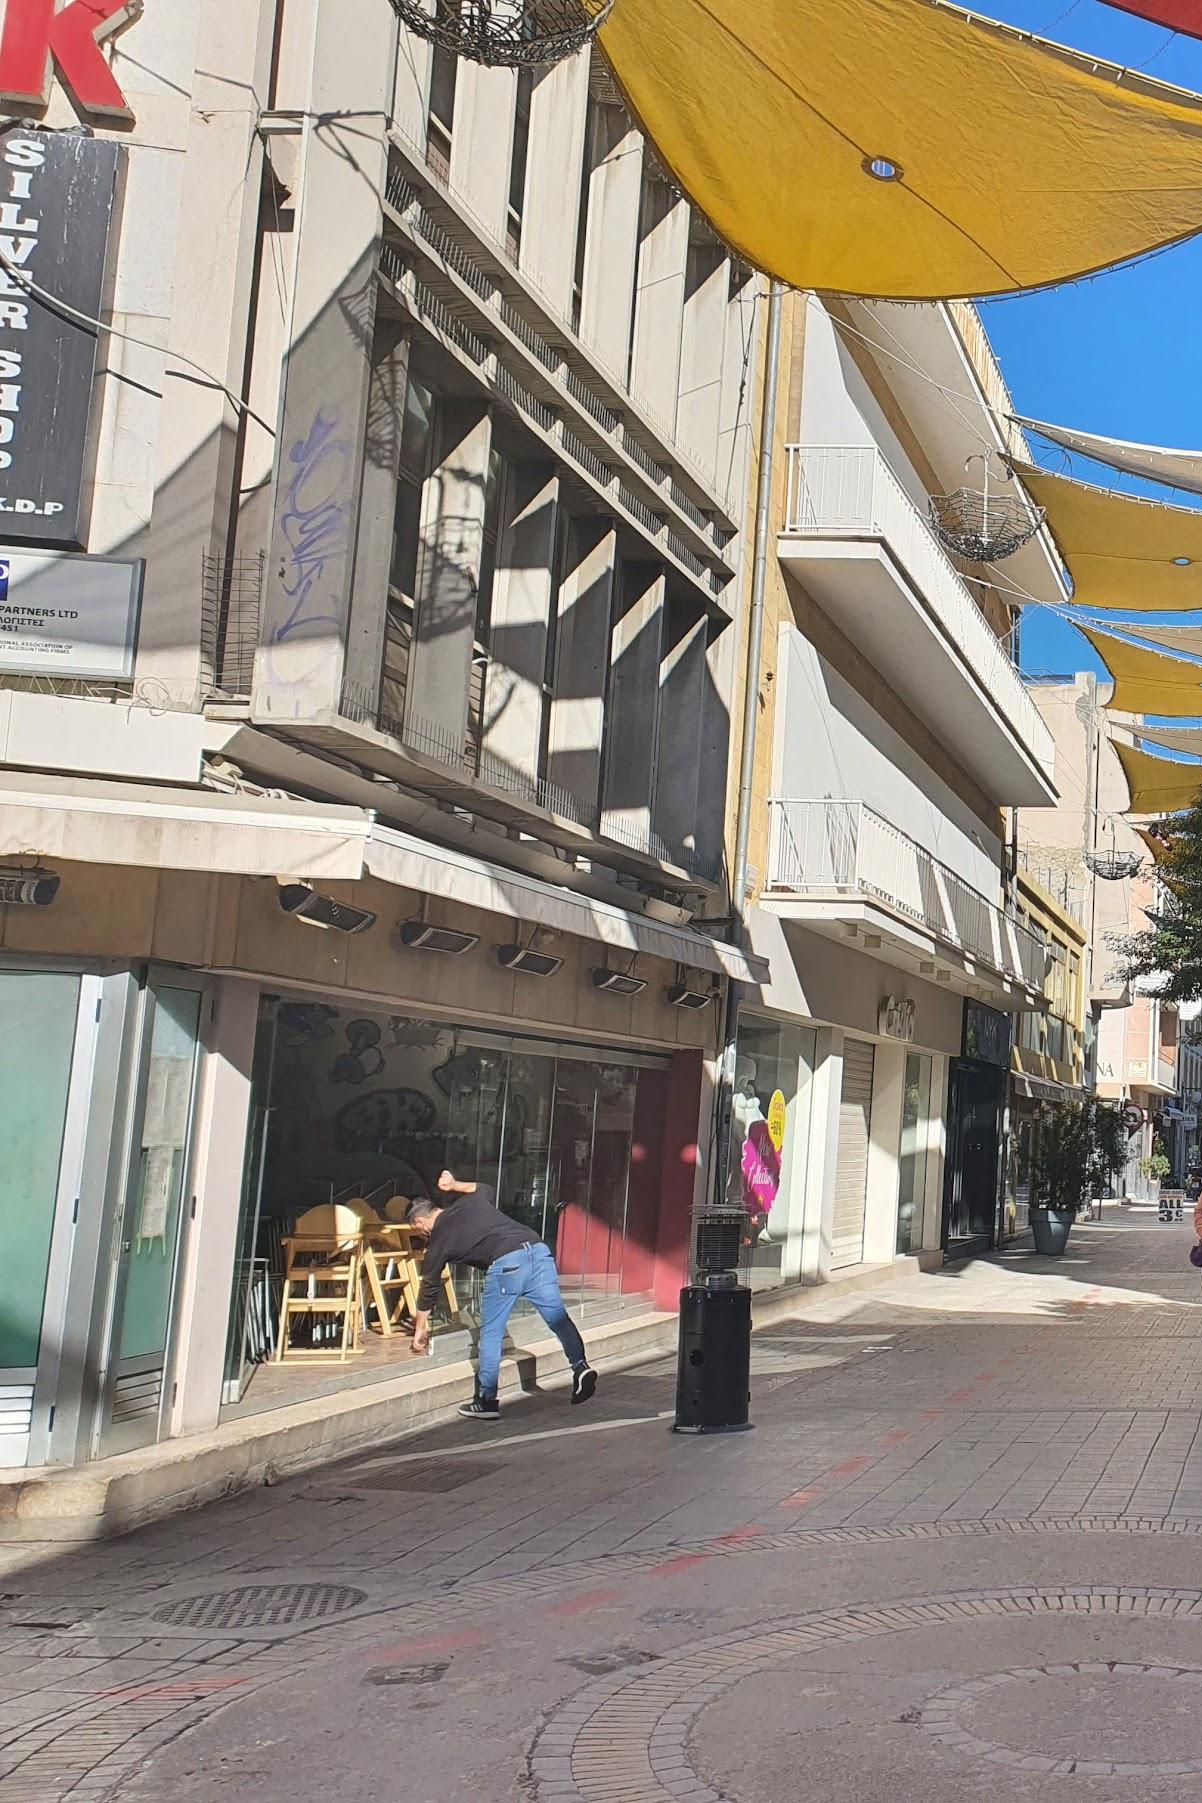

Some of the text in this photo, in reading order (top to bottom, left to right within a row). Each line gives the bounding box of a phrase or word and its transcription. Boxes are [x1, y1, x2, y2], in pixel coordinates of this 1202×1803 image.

[0, 139, 46, 469] SILVER SH
[0, 606, 79, 619] PARTNERS LTD
[1159, 1199, 1183, 1209] ALL
